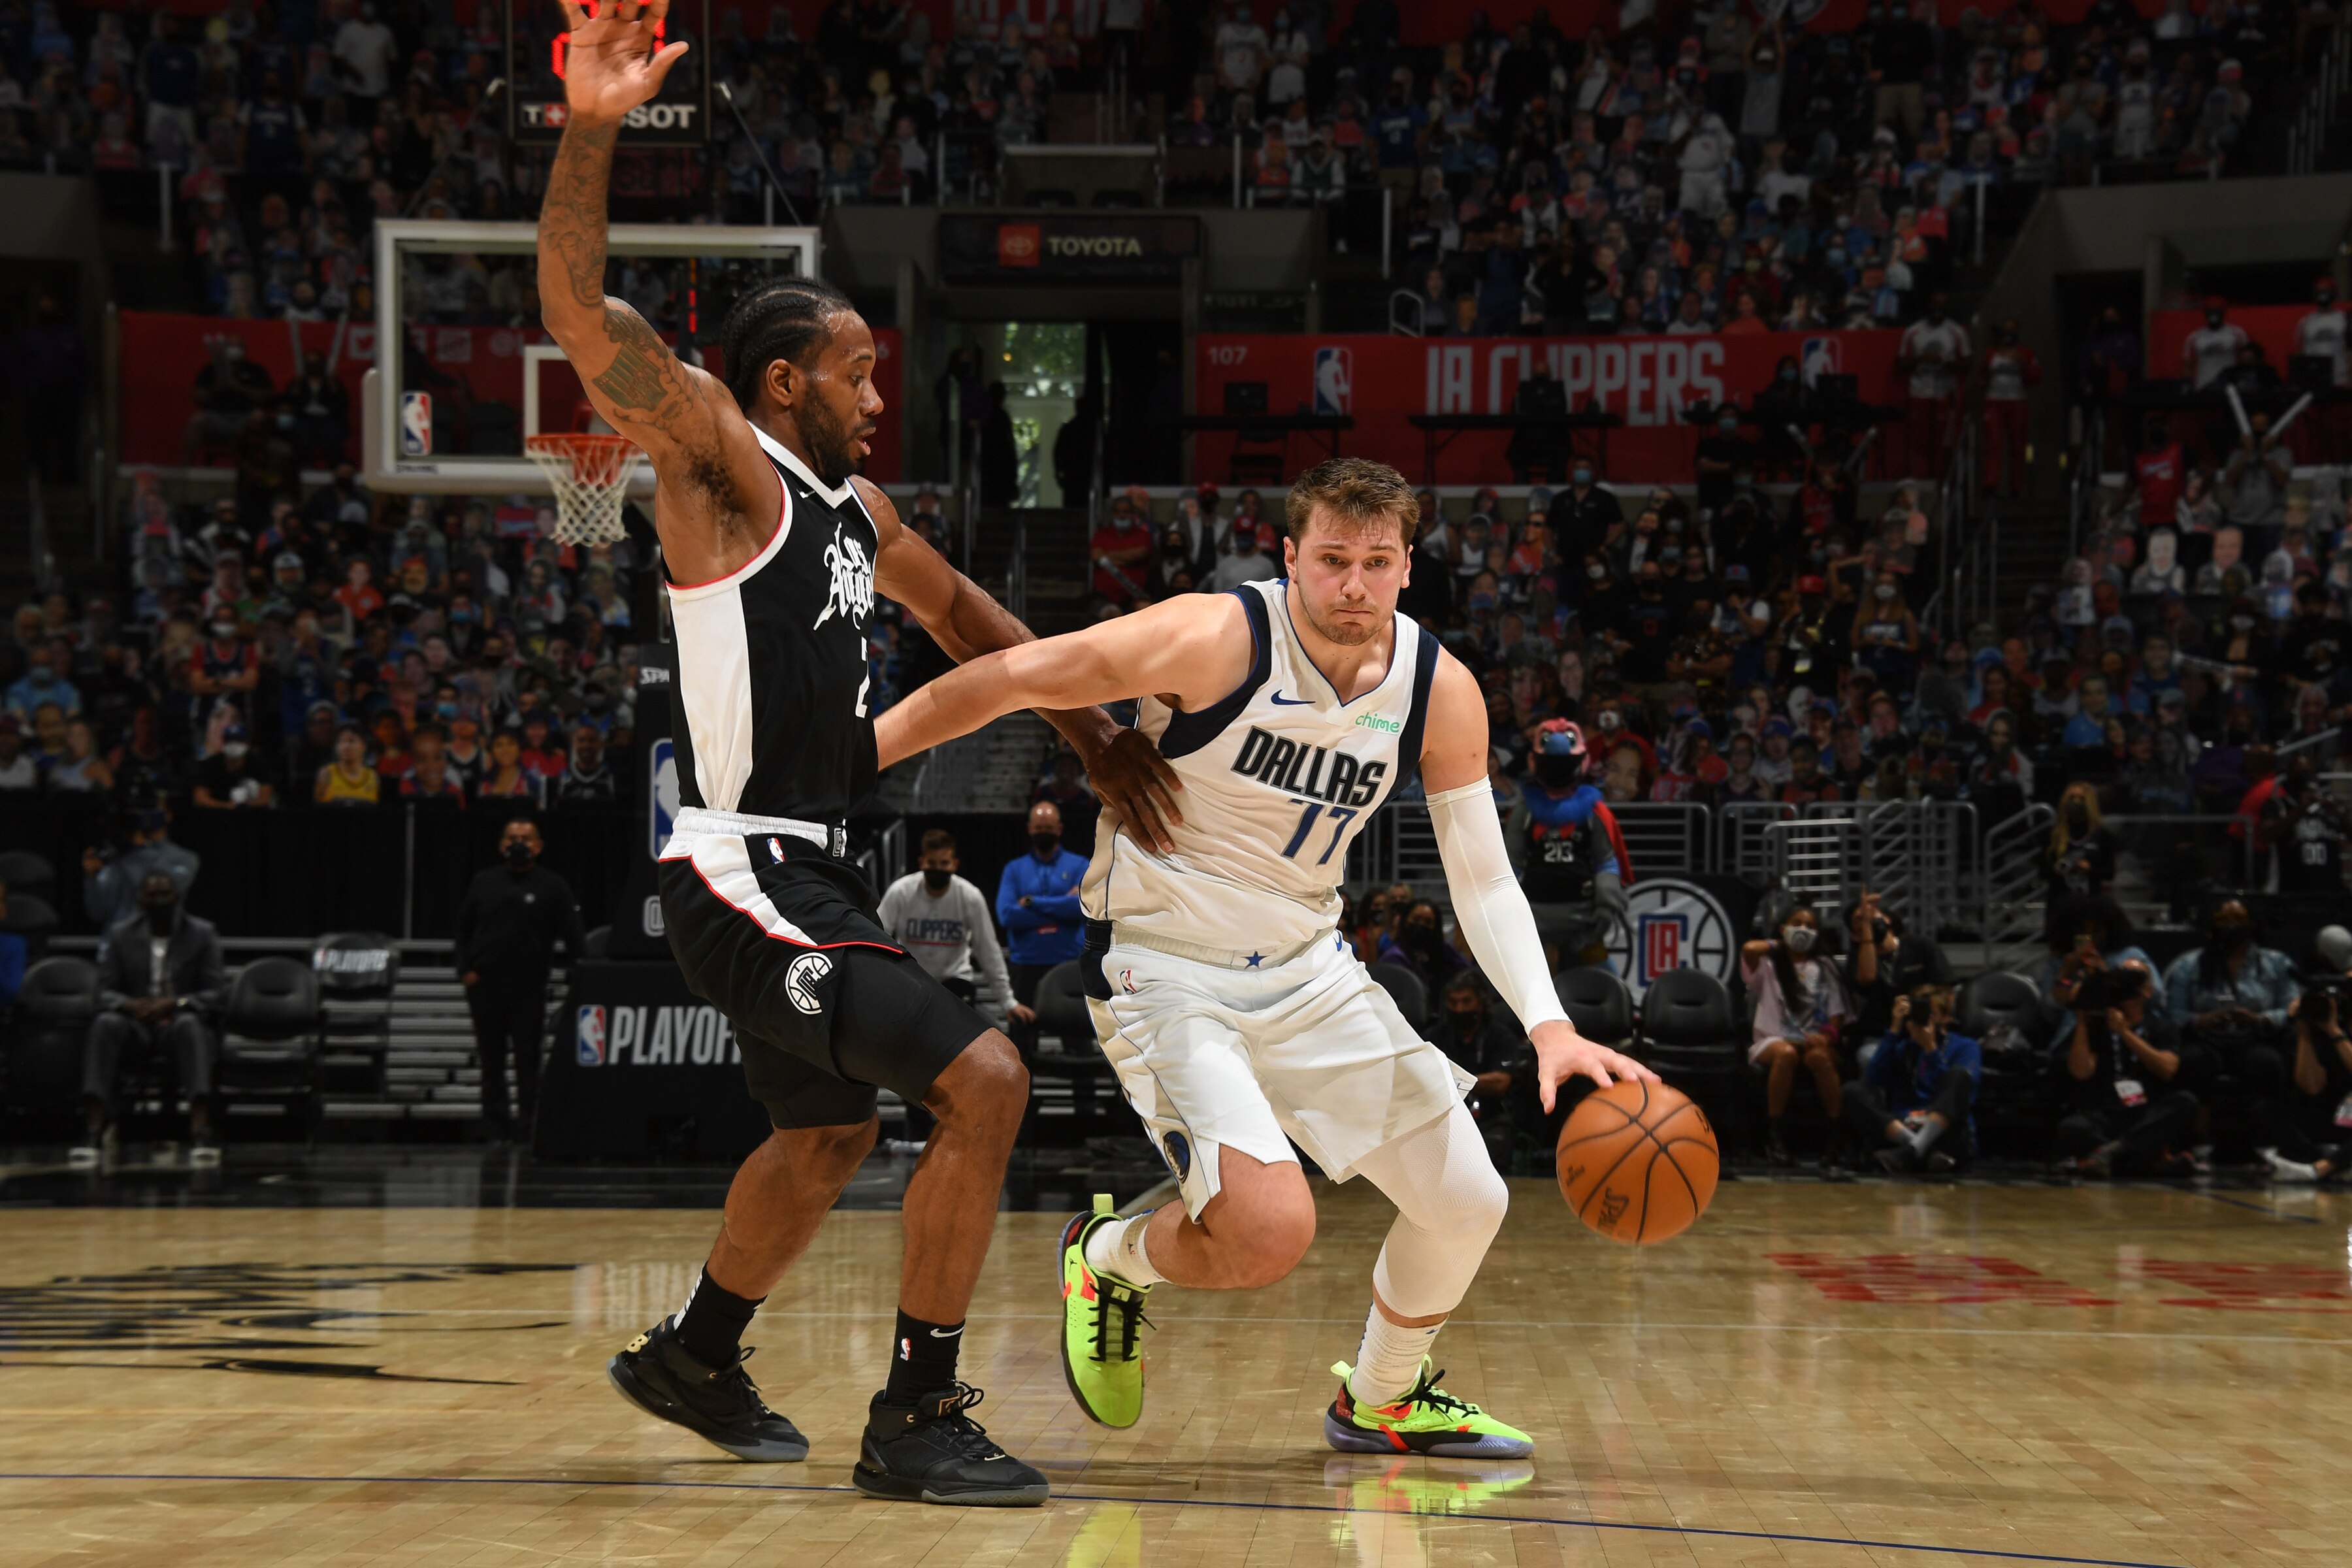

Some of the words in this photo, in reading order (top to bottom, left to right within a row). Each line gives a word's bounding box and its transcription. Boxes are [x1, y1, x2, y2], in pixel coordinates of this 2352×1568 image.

[621, 103, 696, 129] SOT
[1048, 237, 1143, 257] TOYOTA
[1209, 346, 1248, 365] 107
[1355, 711, 1400, 733] chime
[1230, 725, 1388, 808] DALLAS
[1280, 798, 1360, 868] 77
[1543, 841, 1575, 863] 213
[906, 918, 962, 941] CLIPPERS
[607, 1005, 742, 1066] PLAYOF
